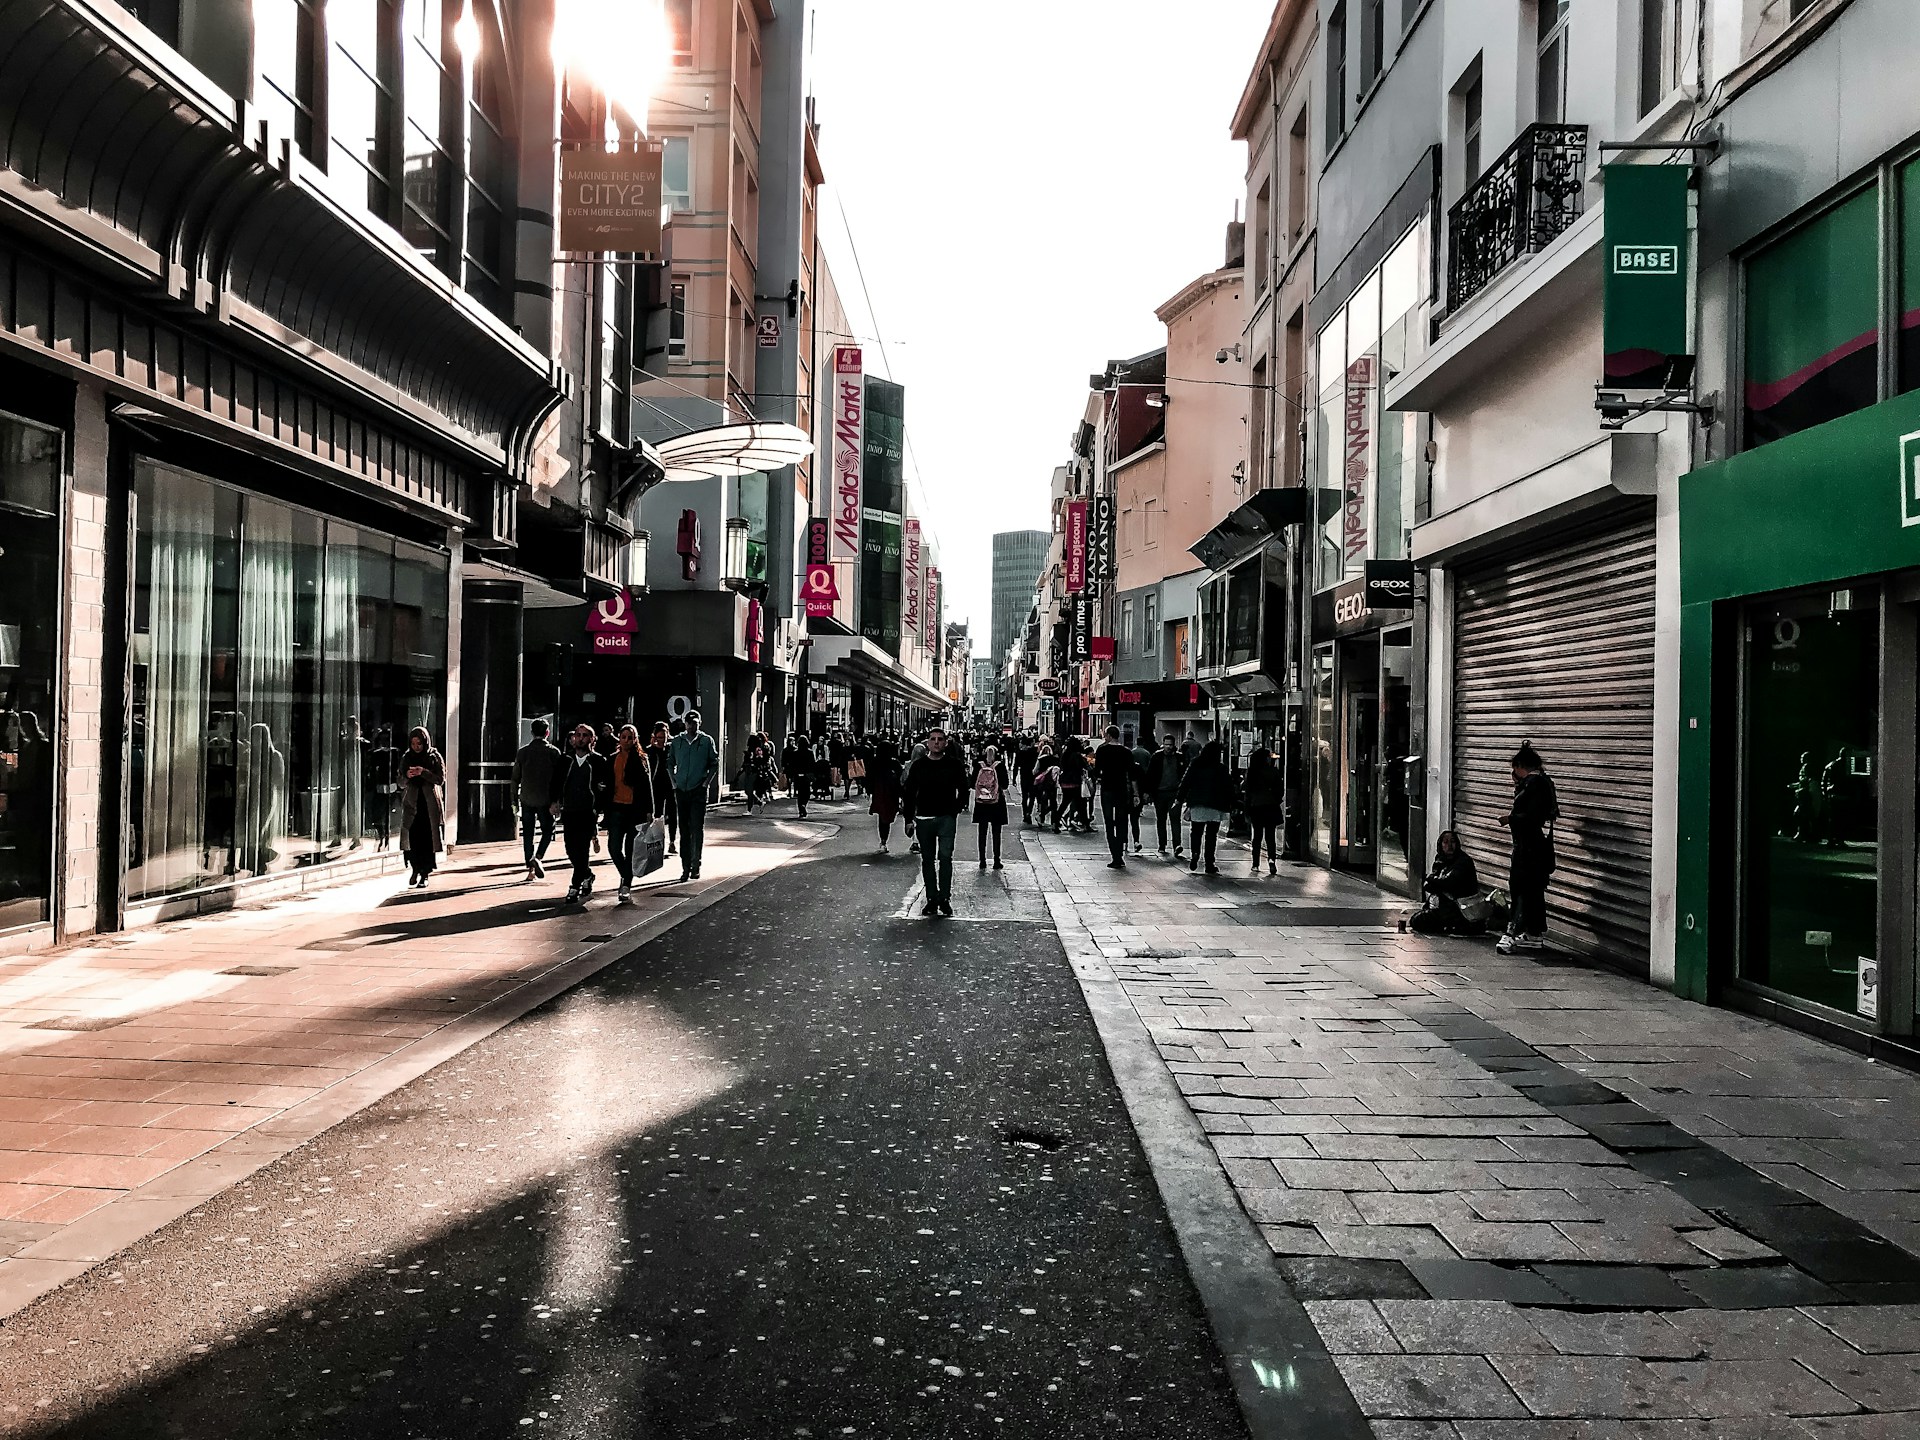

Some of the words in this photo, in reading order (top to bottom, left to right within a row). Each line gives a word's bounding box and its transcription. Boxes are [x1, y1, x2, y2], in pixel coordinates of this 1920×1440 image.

[568, 170, 608, 181] MAKING
[611, 171, 629, 181] THE
[632, 171, 656, 181] NEW
[580, 183, 644, 206] CITY2
[567, 207, 589, 216] EVEN
[590, 208, 614, 217] MORE
[615, 208, 656, 217] EXCITING!
[1620, 252, 1671, 268] BASE
[762, 317, 777, 336] Q
[1099, 500, 1109, 575] MANO
[1068, 557, 1080, 583] Shoe
[809, 569, 832, 595] Q
[1370, 580, 1410, 588] GEOX
[598, 592, 627, 626] Q
[807, 602, 832, 611] Quick
[595, 636, 628, 648] Quick
